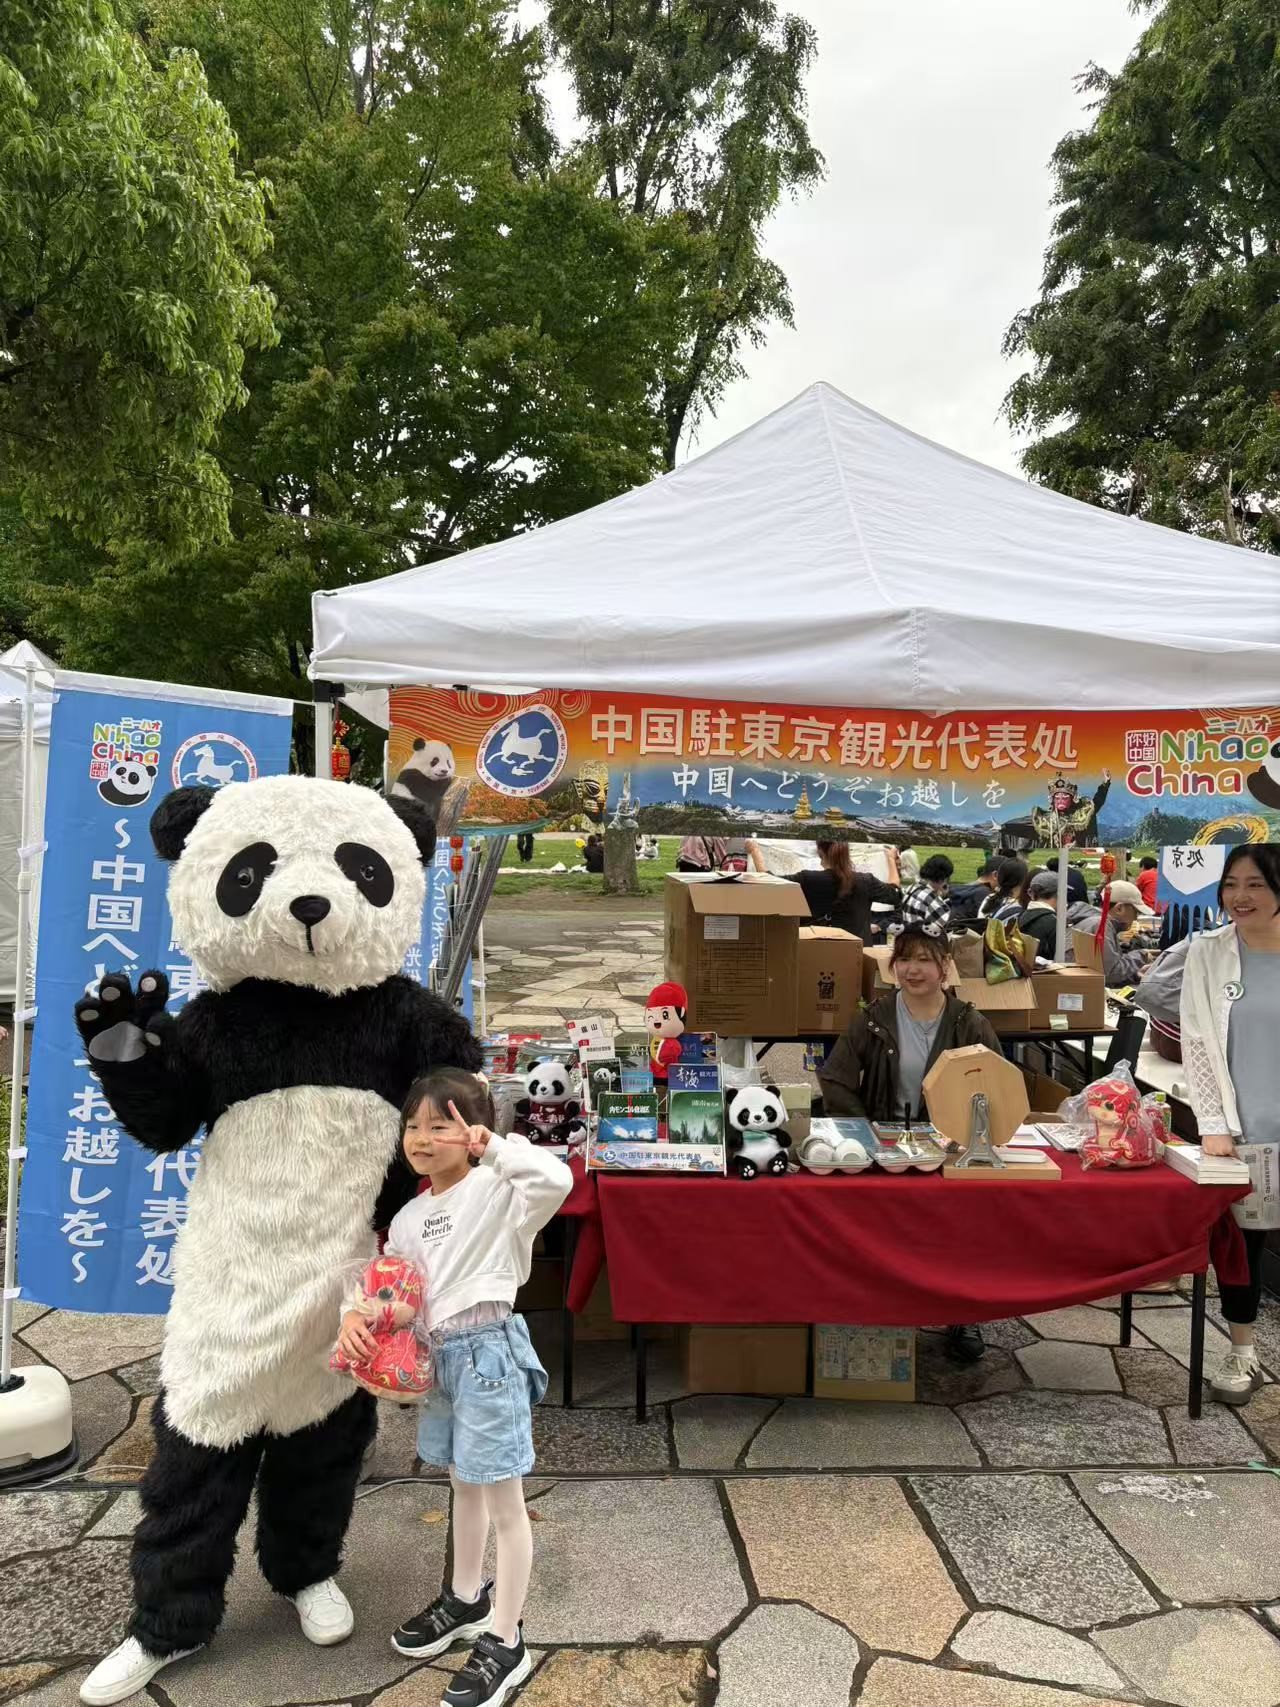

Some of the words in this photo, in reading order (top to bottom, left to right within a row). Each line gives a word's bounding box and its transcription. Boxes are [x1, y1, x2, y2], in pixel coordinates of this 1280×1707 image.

[121, 717, 162, 731] ニーハオ
[1206, 715, 1272, 734] ニーハオ
[93, 723, 161, 747] Nihao
[591, 704, 1079, 771] 中国駐東京観光代表処
[1128, 732, 1157, 748] 你好
[92, 743, 159, 764] China
[1129, 747, 1157, 762] 中国
[1161, 730, 1269, 763] Nihao
[672, 762, 1006, 811] 中国へどうぞお越しを
[1126, 763, 1244, 797] China
[424, 1214, 451, 1228] Quatre
